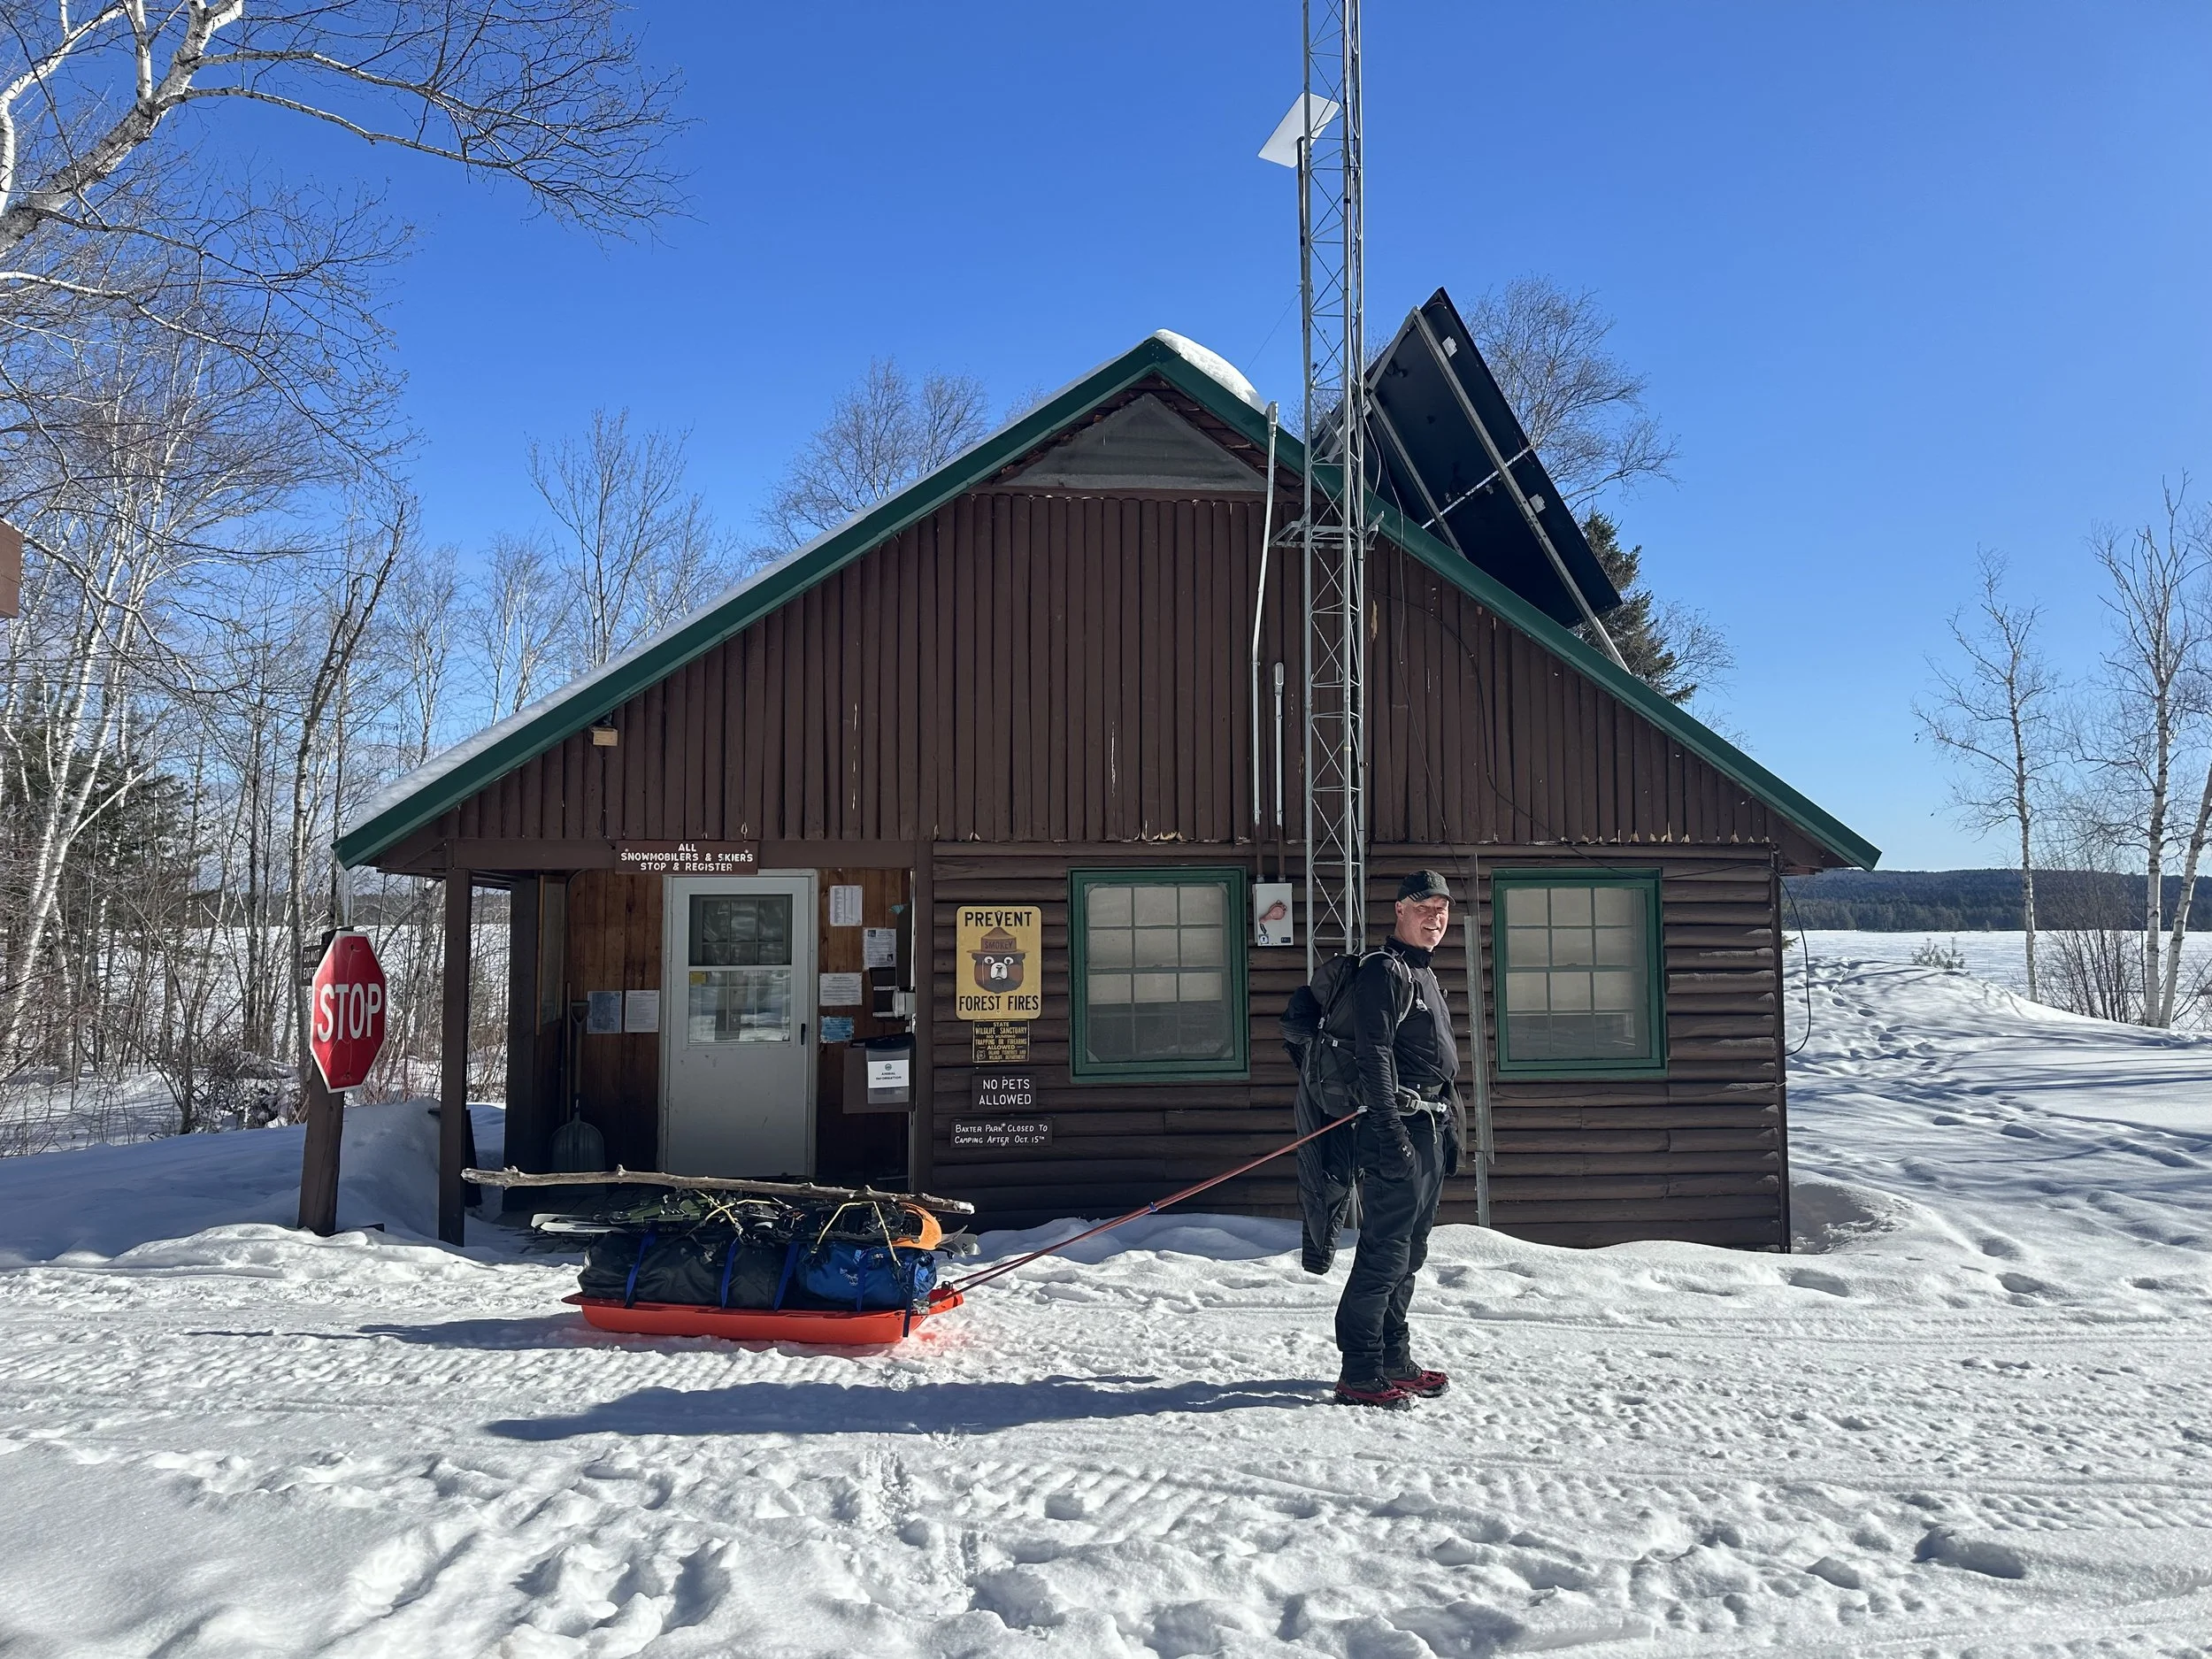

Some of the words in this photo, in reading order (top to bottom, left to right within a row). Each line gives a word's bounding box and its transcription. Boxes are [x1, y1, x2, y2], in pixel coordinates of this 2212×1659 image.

[678, 843, 697, 852] ALL
[620, 852, 699, 862] SNOWMOBILERS
[704, 853, 712, 862] &
[718, 853, 754, 863] SKIERS
[672, 863, 680, 872] &
[685, 863, 733, 872] REGISTER
[964, 911, 1033, 927] PREVENT
[984, 941, 1014, 950] SMOKEY
[959, 995, 1002, 1011] FOREST
[1008, 995, 1039, 1010] FIRES
[317, 982, 382, 1043] STOP
[983, 1079, 998, 1090] NO
[1002, 1079, 1030, 1090] PETS
[979, 1094, 1032, 1105] ALLOWED
[955, 1124, 982, 1133] BAXTER
[985, 1124, 1002, 1133] PARK
[1007, 1124, 1034, 1133] CLOSED
[954, 1135, 983, 1144] CAMPING
